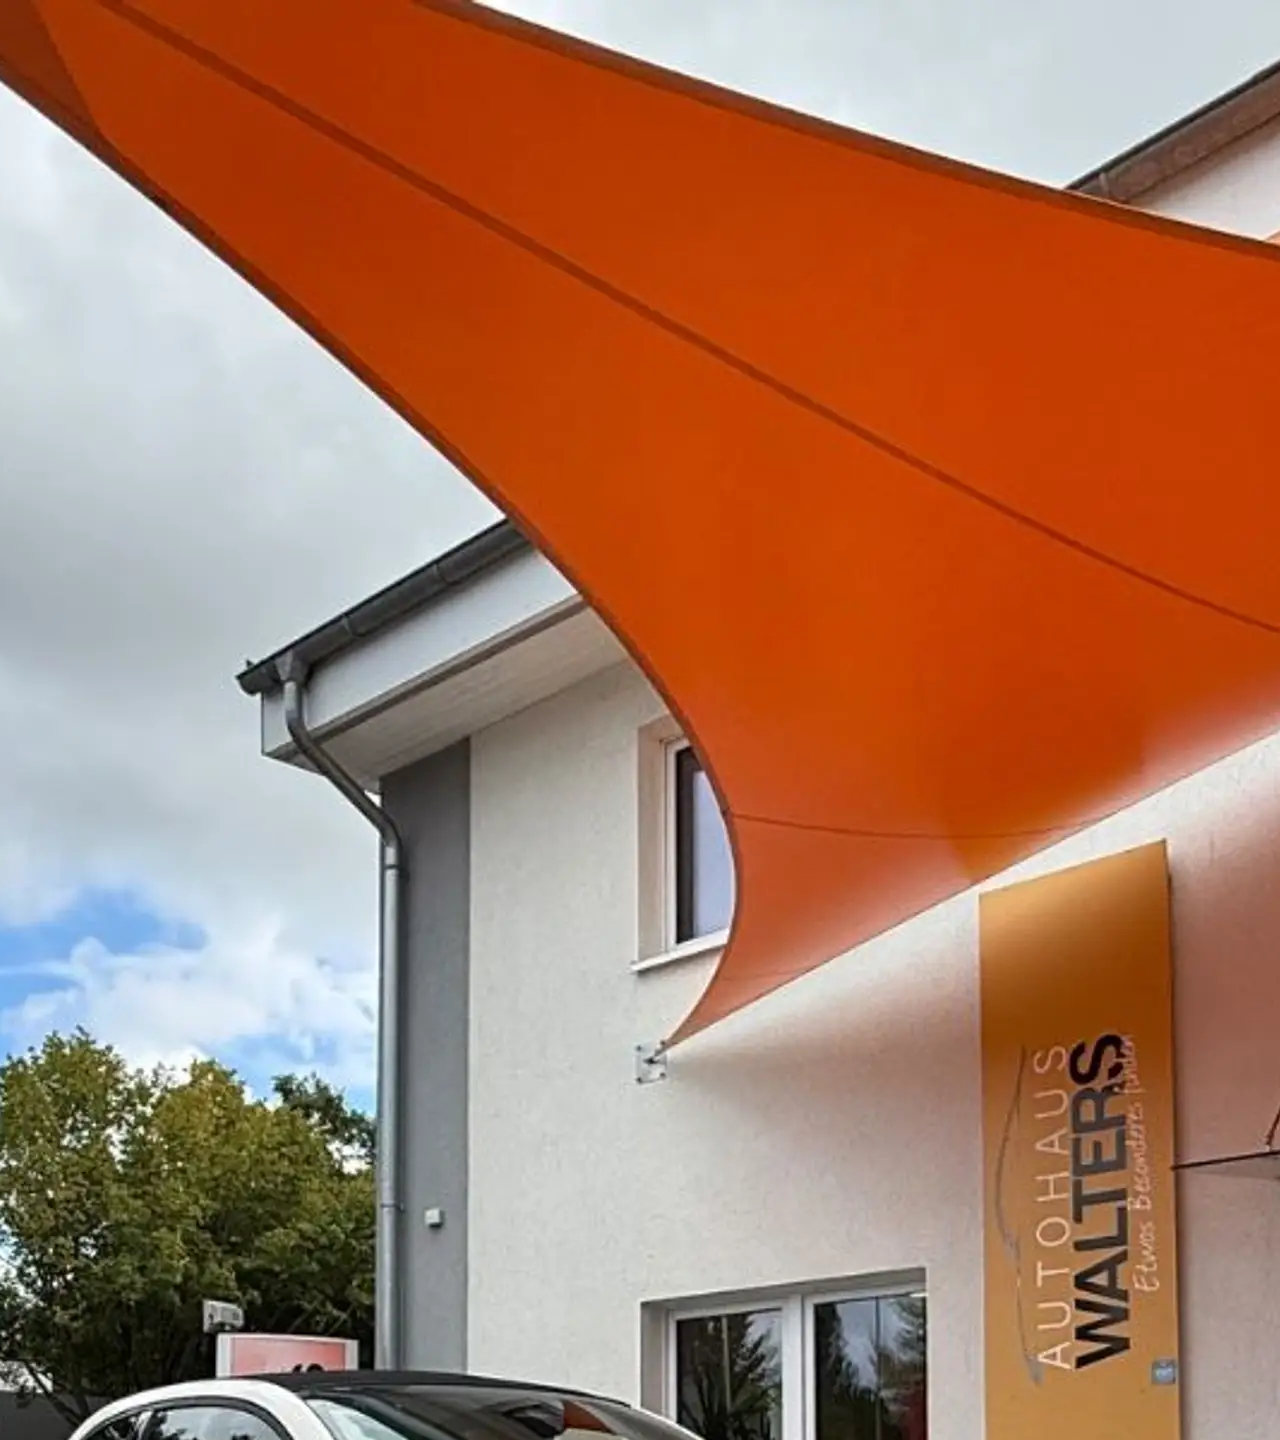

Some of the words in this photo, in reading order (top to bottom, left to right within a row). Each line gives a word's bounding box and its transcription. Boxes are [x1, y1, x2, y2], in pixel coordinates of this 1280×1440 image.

[1033, 1045, 1072, 1370] AUTOHAUS
[1070, 1033, 1131, 1370] WALTERS
[1131, 1220, 1160, 1292] Etwas
